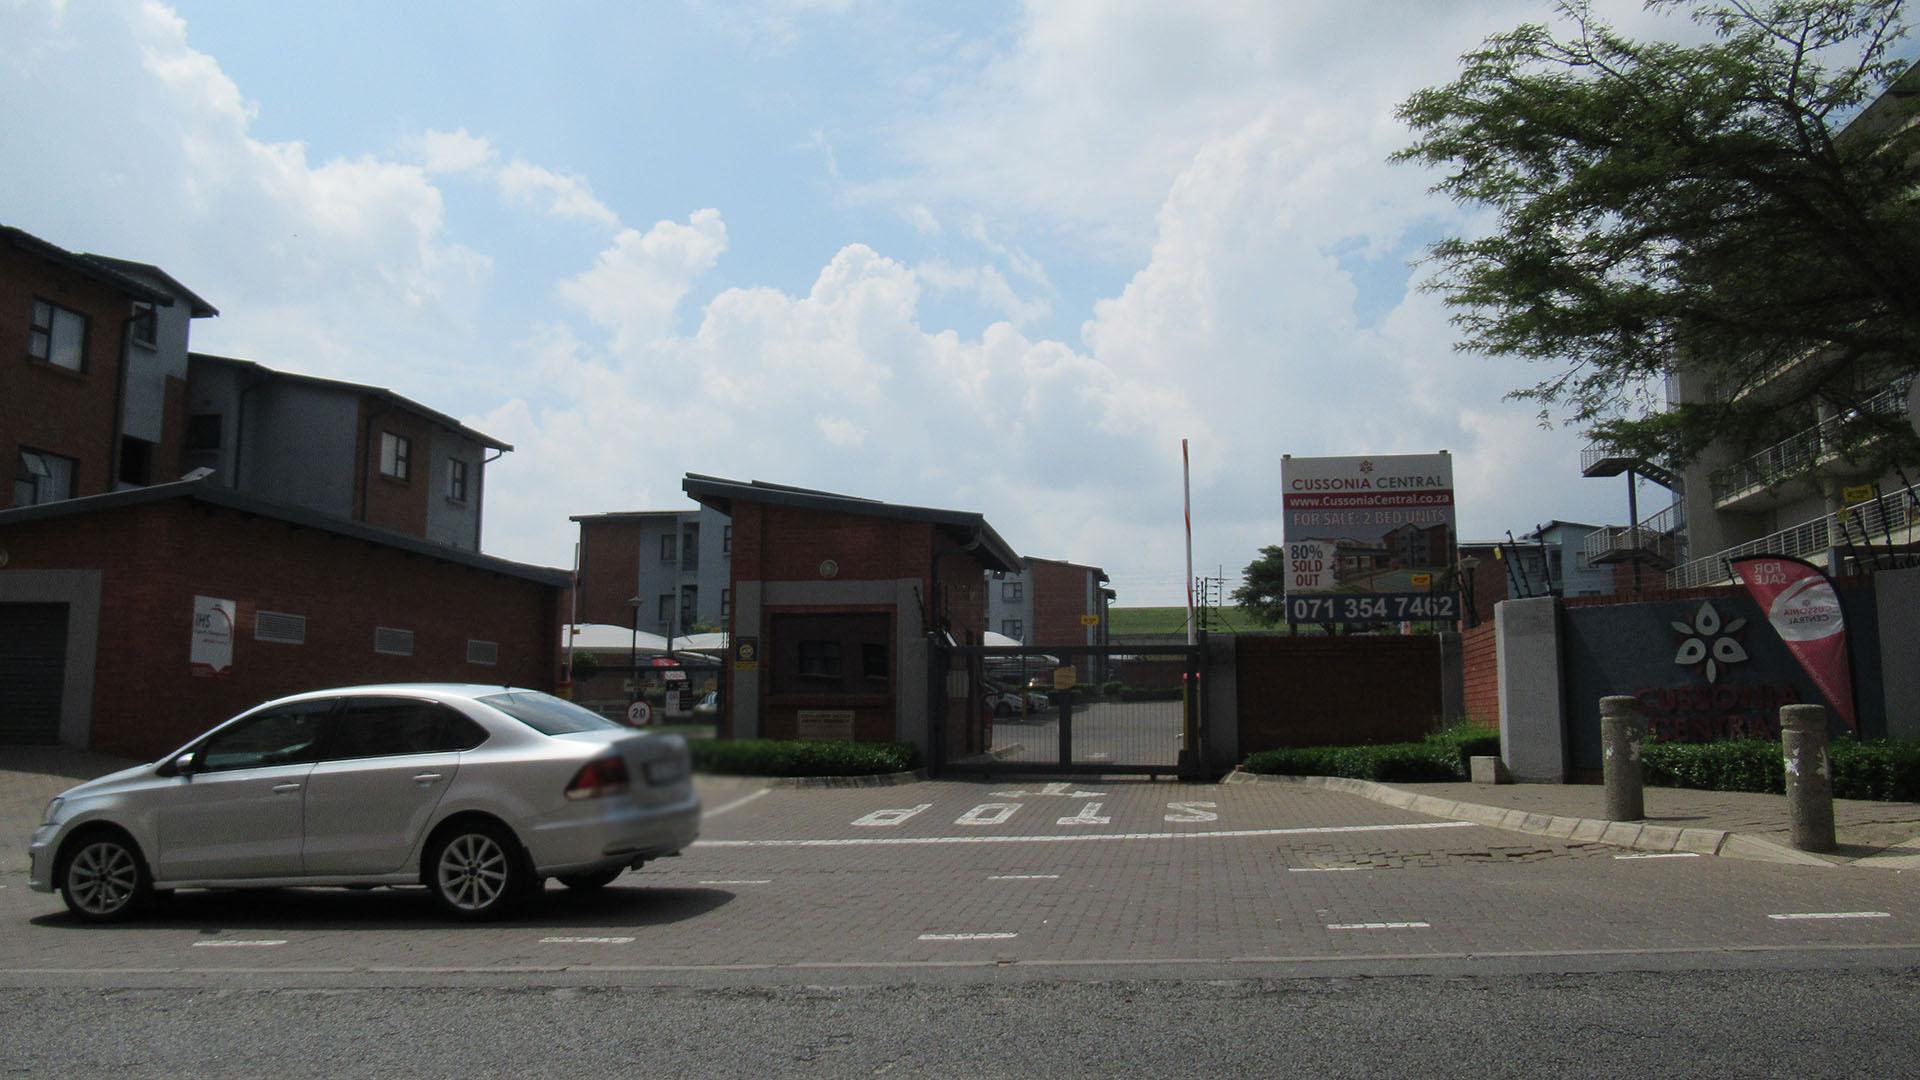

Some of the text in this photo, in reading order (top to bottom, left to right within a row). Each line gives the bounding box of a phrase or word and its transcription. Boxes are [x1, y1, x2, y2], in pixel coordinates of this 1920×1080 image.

[1292, 475, 1443, 490] CUSSONIA CENTRAL
[1289, 493, 1449, 506] www.CussoniaCentral.co.za
[1293, 509, 1447, 526] FOR SALE: 2 BED UNITS
[1291, 544, 1323, 560] 80%
[1292, 560, 1323, 572] SOLD
[1295, 574, 1320, 587] OUT
[1294, 596, 1453, 618] 071 354 7462
[632, 708, 646, 719] 20
[850, 801, 1219, 826] STOP
